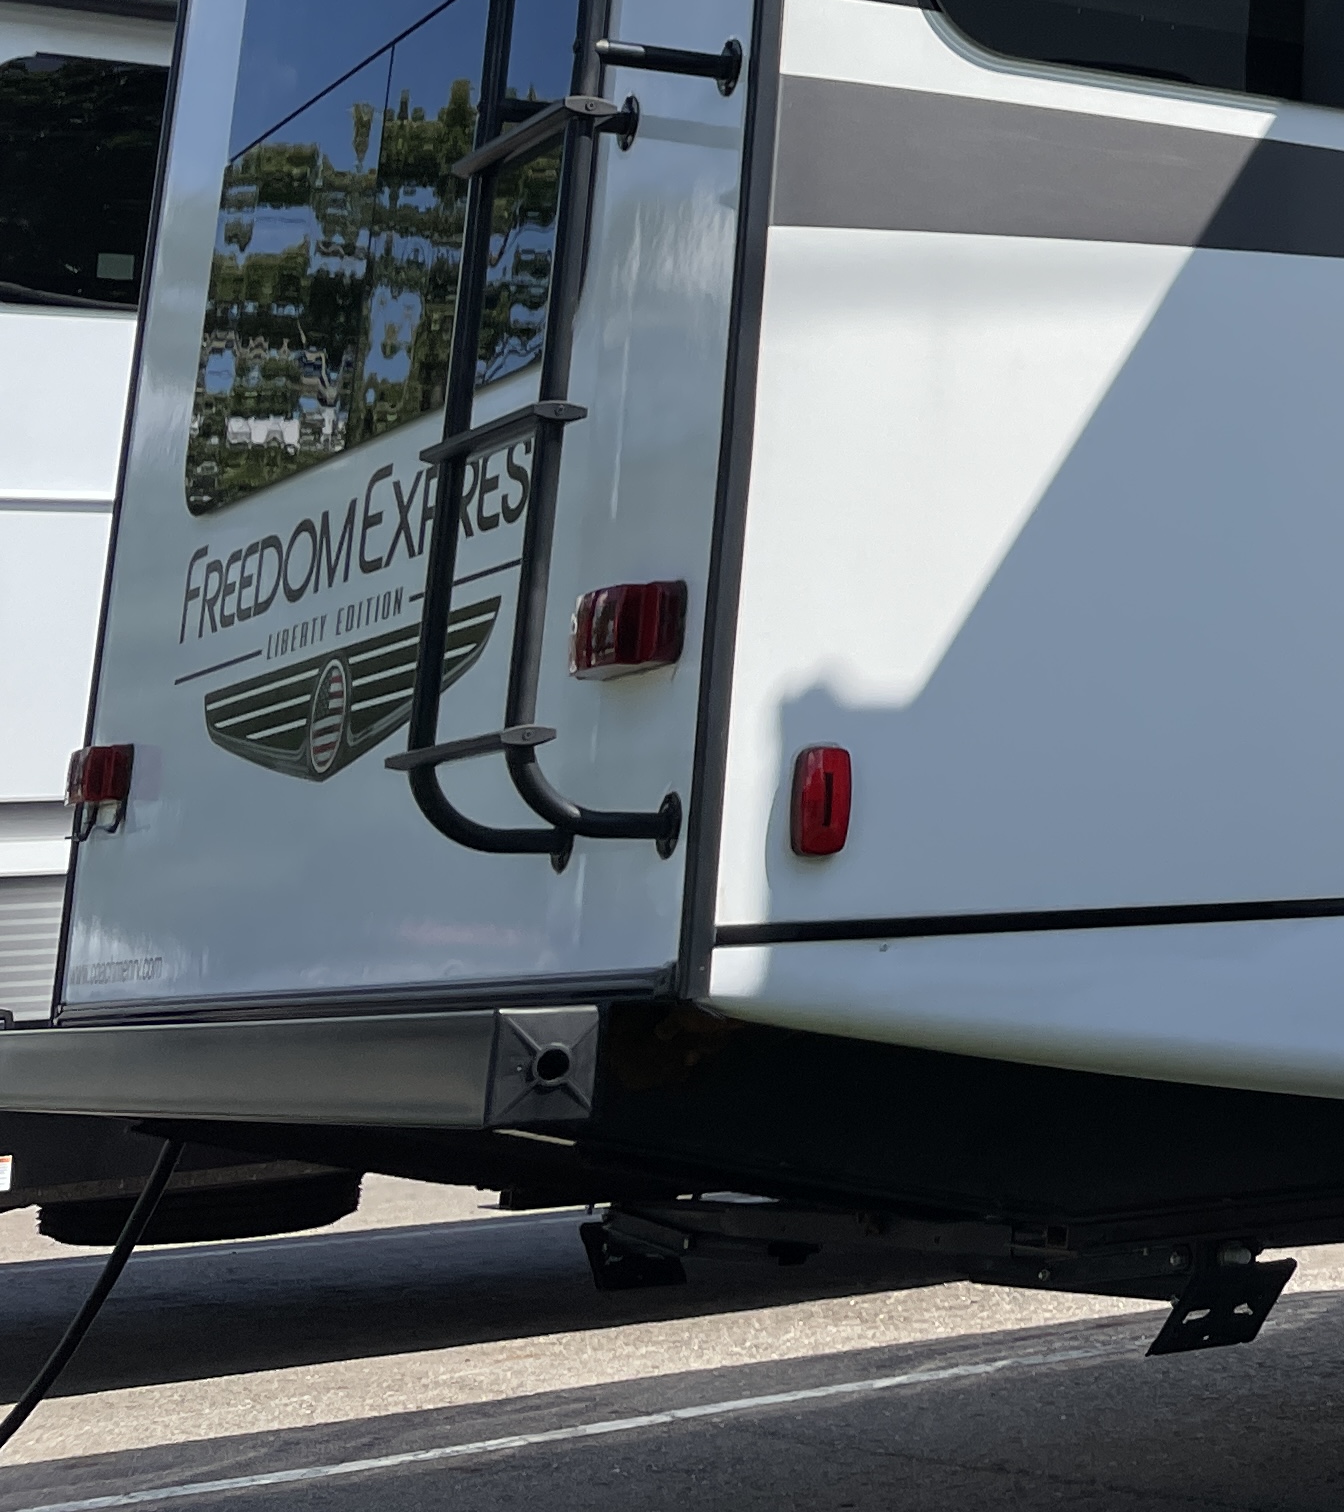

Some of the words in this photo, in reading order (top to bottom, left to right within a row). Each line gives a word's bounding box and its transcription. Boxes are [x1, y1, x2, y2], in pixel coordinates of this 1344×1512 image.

[358, 437, 533, 575] EXPRES
[266, 615, 328, 660] LIBERTY
[335, 587, 404, 636] EDITION
